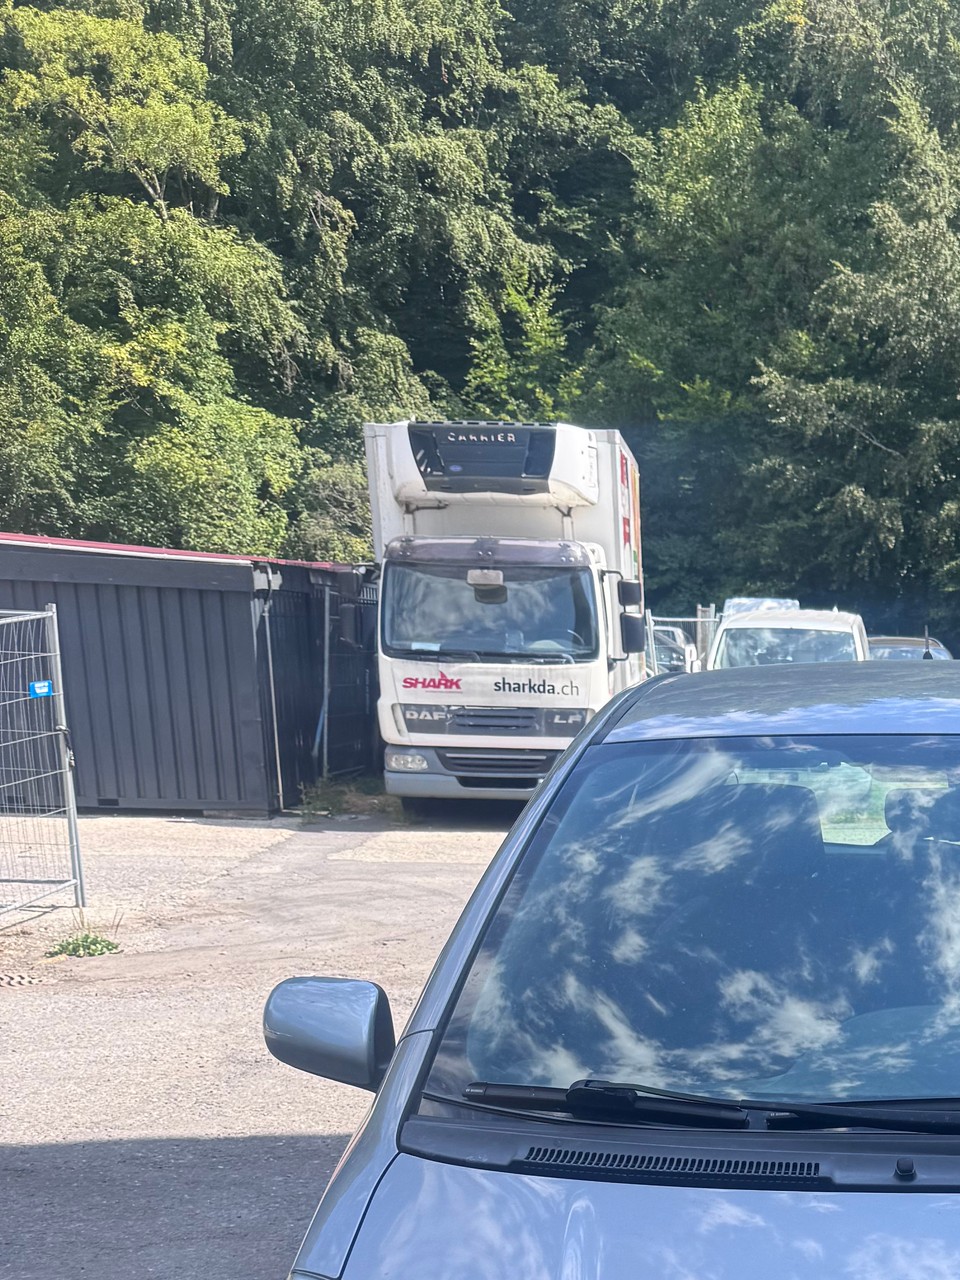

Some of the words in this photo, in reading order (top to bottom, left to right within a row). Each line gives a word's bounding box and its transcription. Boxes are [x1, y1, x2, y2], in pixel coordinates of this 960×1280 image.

[402, 676, 462, 690] SHARK
[494, 677, 579, 696] sharkda.ch
[405, 710, 445, 720] DAF
[554, 714, 582, 724] LF
